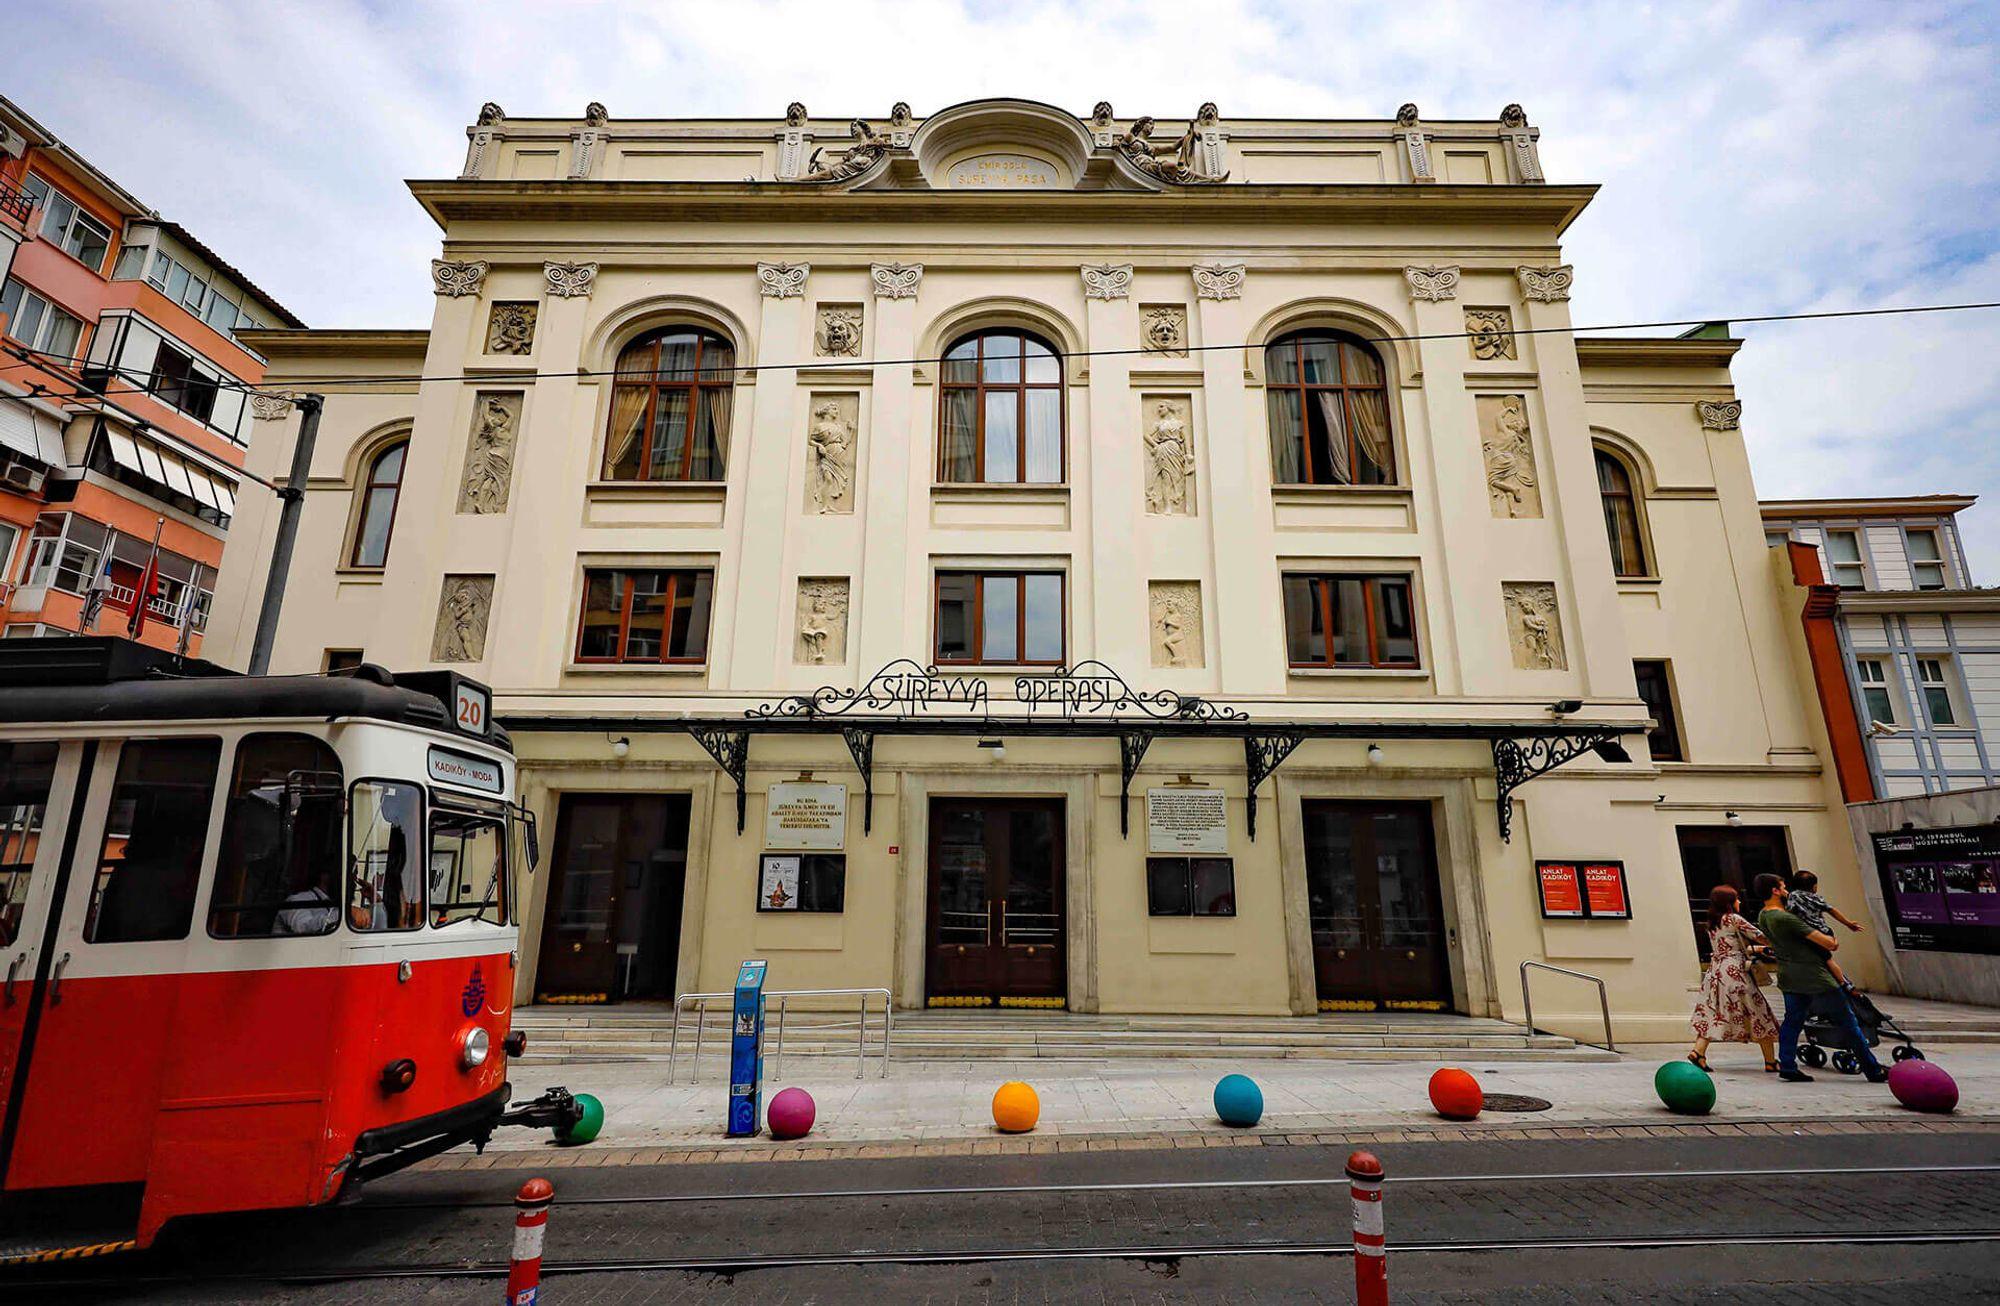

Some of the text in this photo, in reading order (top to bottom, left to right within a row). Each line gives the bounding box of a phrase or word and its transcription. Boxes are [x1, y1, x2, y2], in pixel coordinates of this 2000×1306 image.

[878, 673, 1114, 713] SÜREYYA OPERASI
[459, 697, 481, 726] 20
[434, 760, 467, 776] KADIKÖY
[472, 770, 493, 782] MODA
